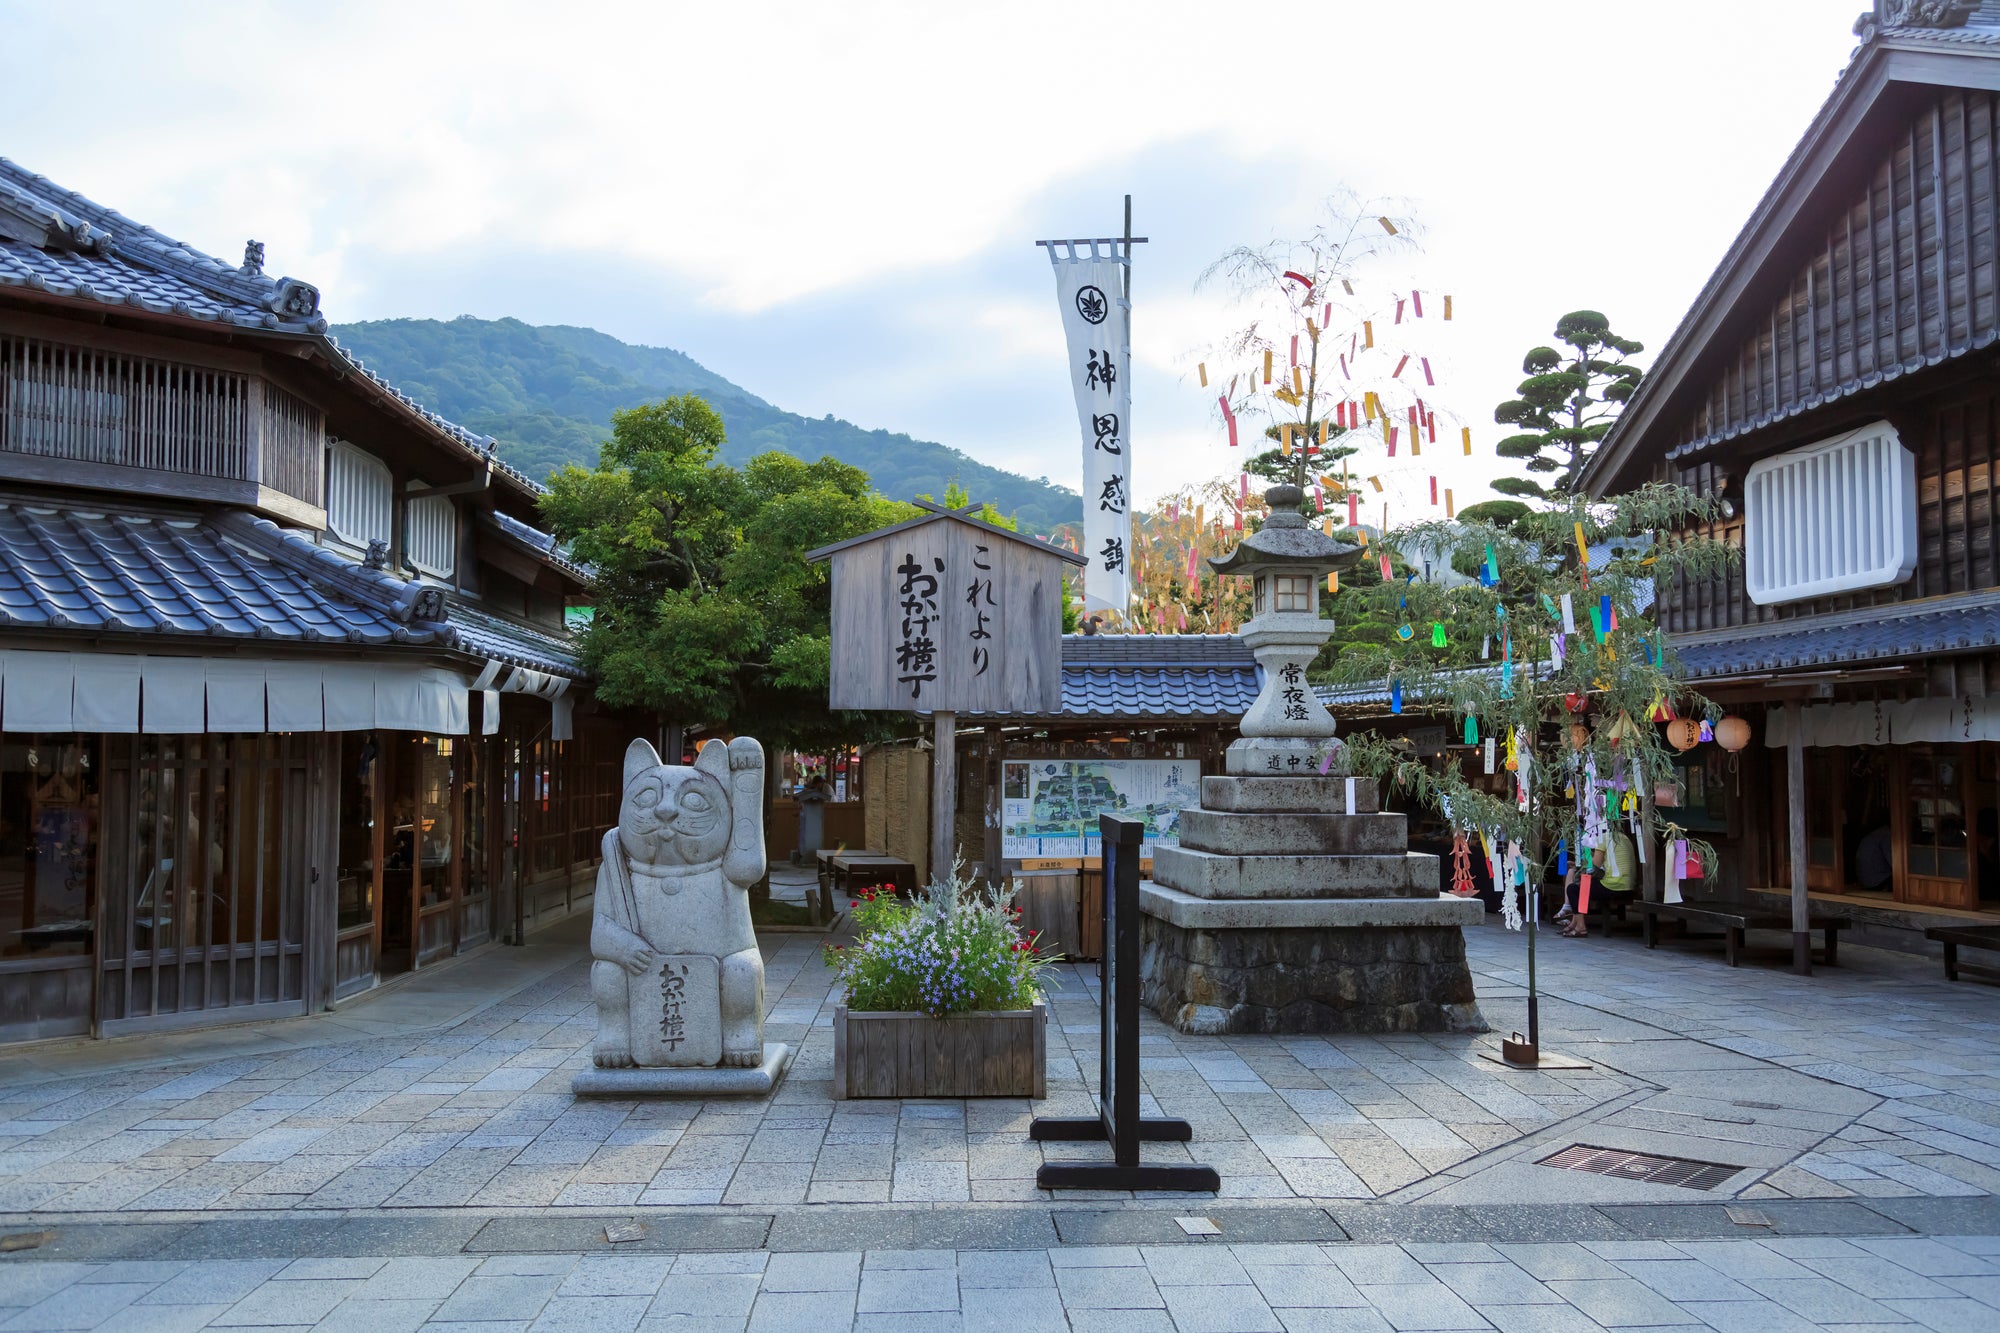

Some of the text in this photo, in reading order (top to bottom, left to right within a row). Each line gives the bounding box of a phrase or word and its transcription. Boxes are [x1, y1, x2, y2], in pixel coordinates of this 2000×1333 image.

[1085, 348, 1126, 576] 神恩感謝
[896, 553, 945, 699] おかげ横丁
[966, 544, 997, 677] これより
[1278, 662, 1310, 721] 常夜燈
[658, 963, 689, 1053] おかげ横丁
